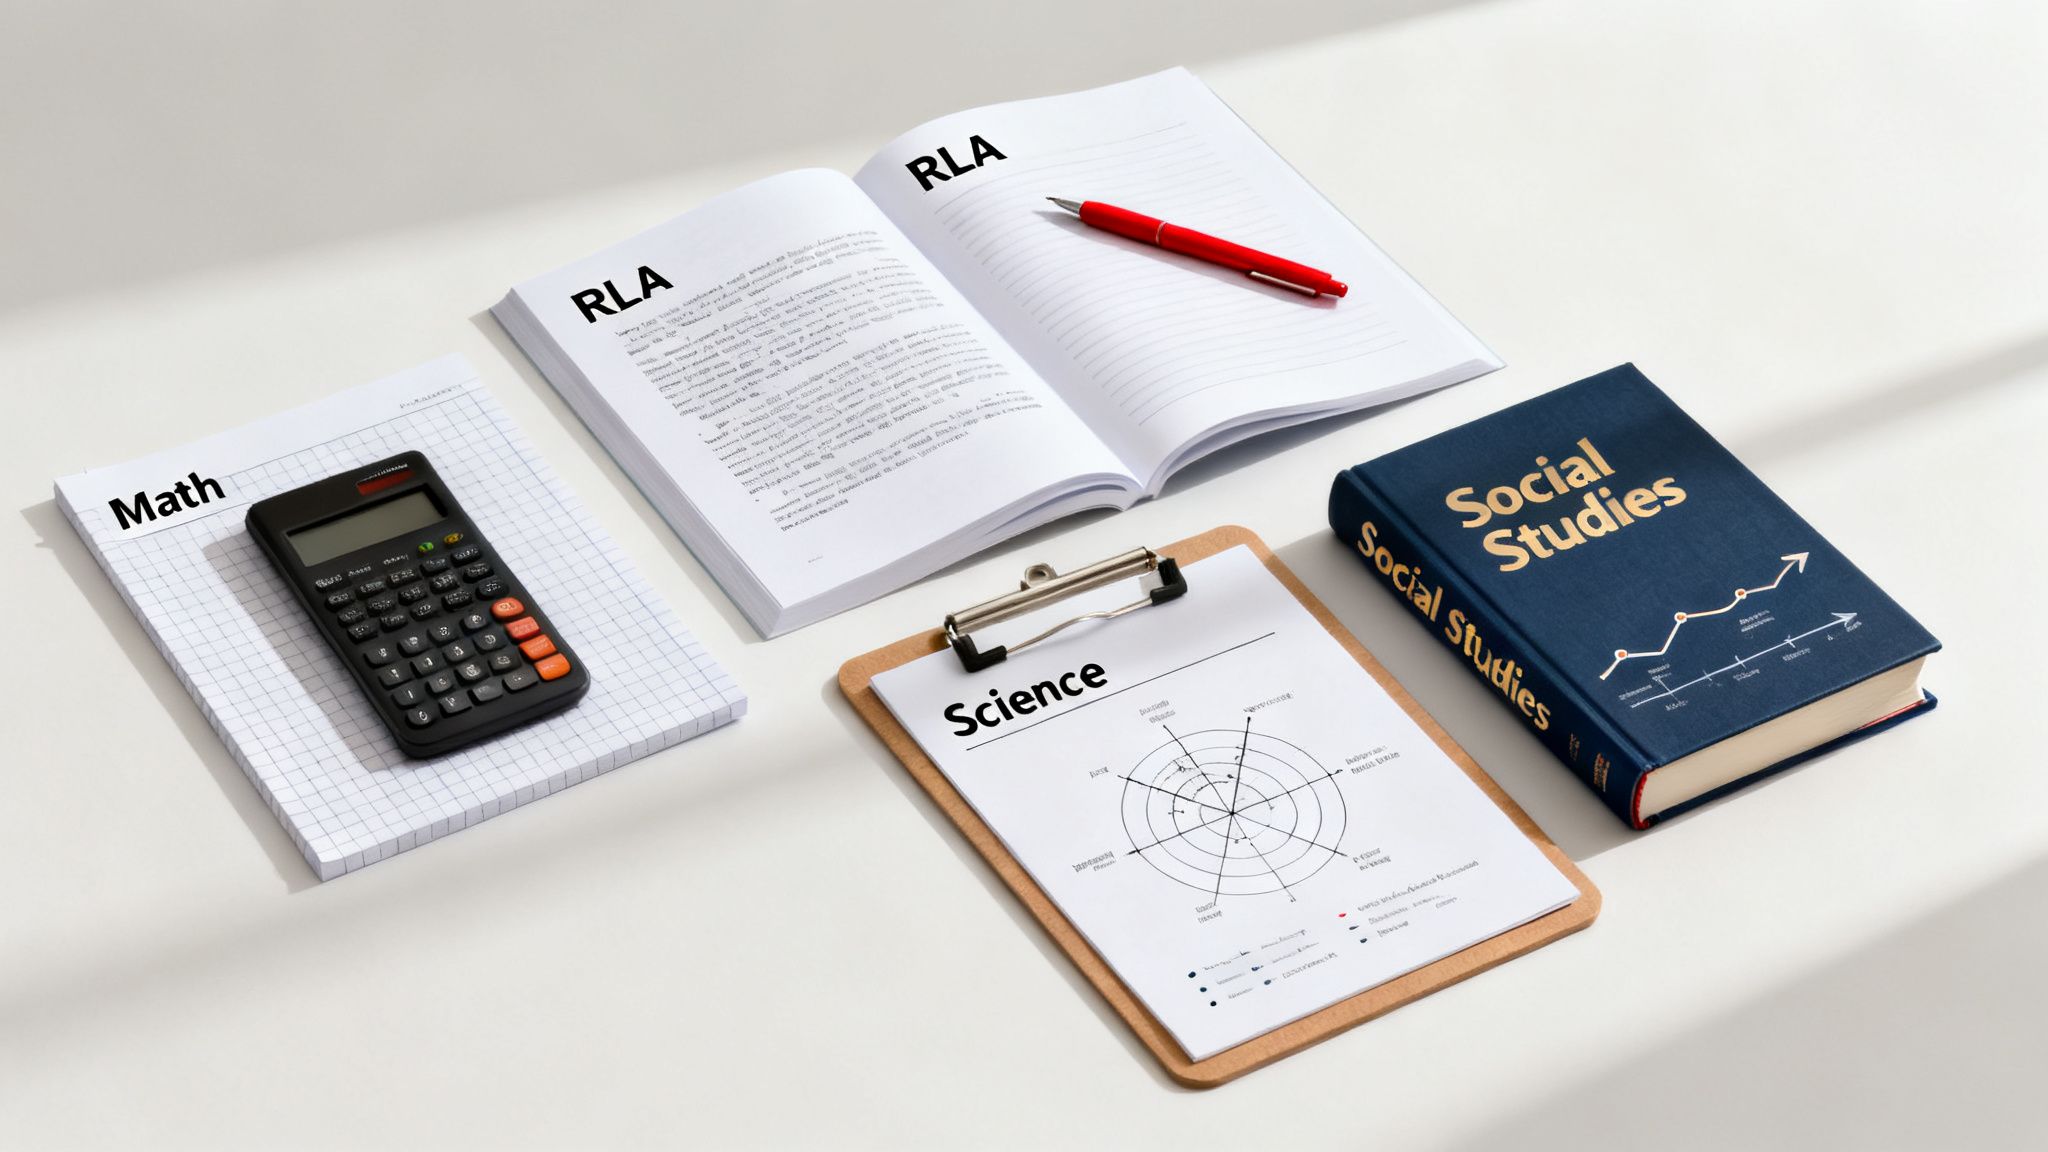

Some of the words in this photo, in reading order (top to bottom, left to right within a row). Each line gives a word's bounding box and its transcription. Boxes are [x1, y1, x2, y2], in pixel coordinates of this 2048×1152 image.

[905, 135, 1008, 191] RLA
[571, 266, 674, 324] RLA
[109, 471, 226, 531] Math
[1445, 437, 1617, 529] Social
[1482, 477, 1687, 573] Studies
[1356, 520, 1443, 624] Social
[1444, 607, 1552, 732] Studies
[944, 650, 1108, 737] Science
